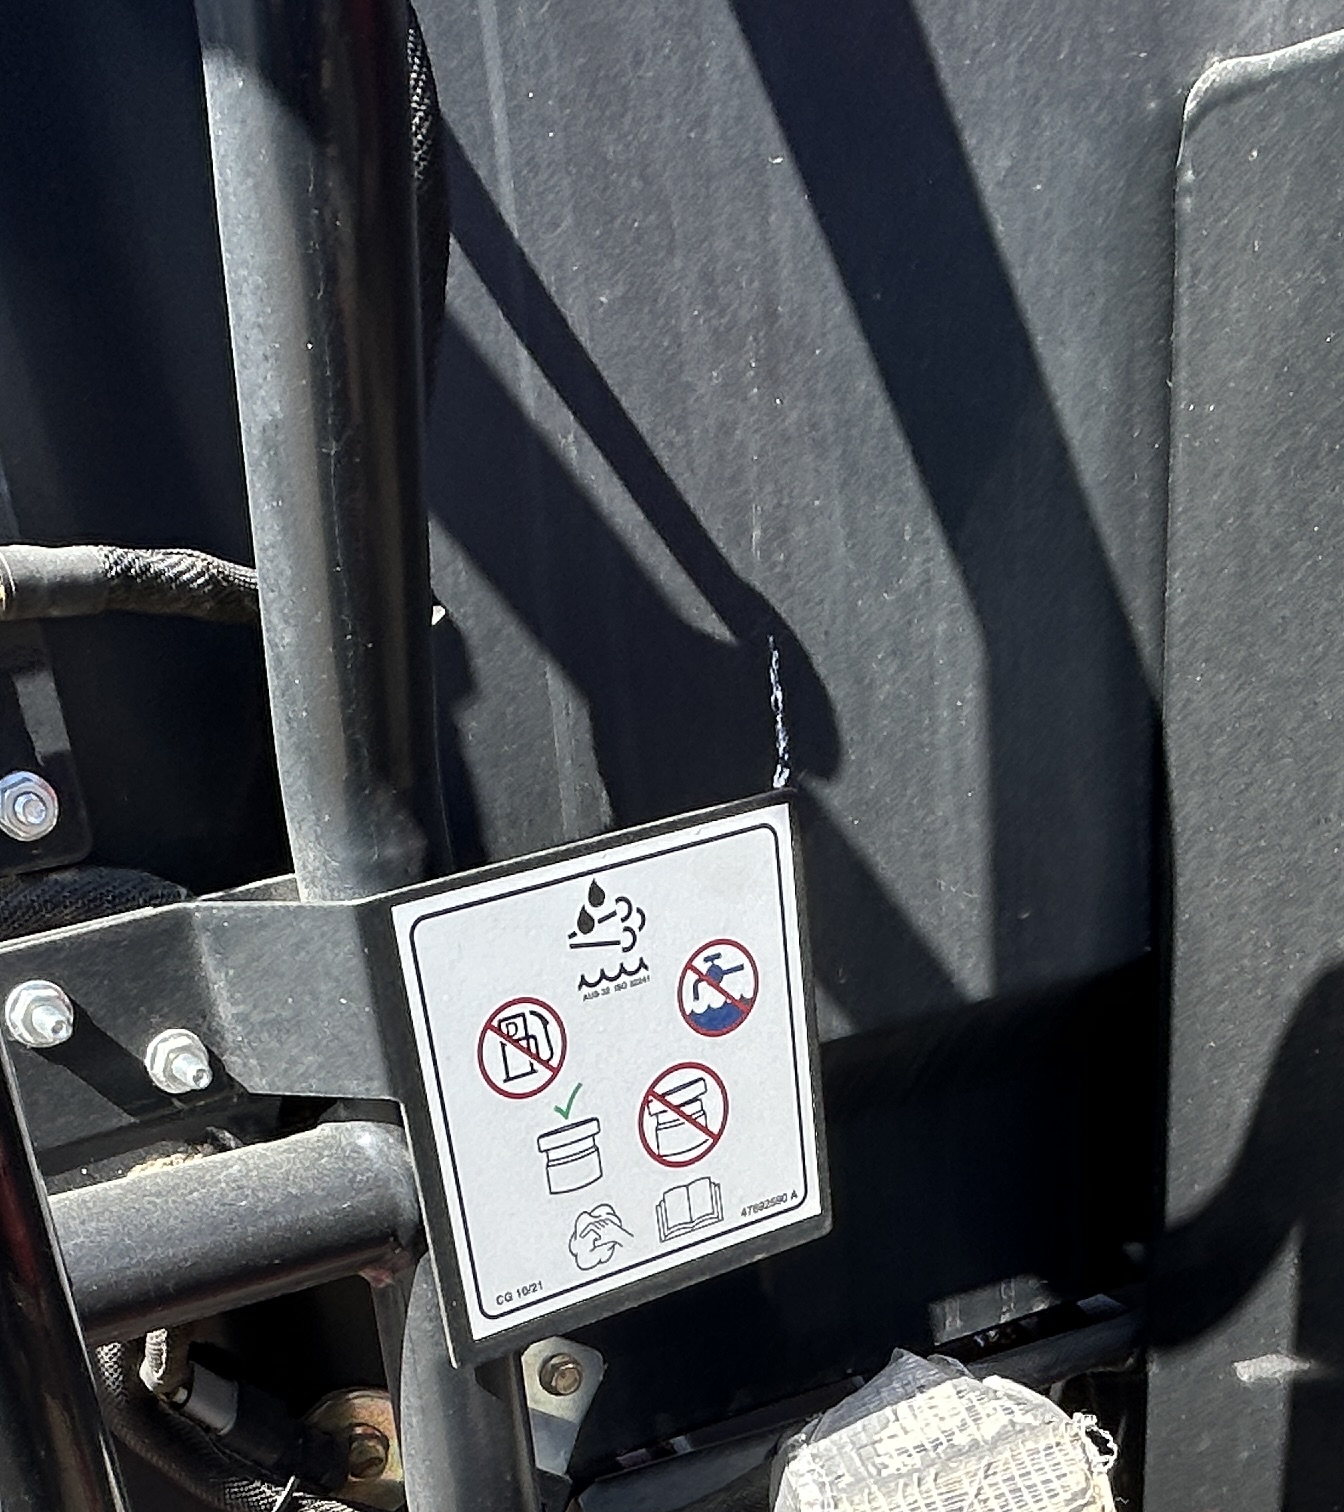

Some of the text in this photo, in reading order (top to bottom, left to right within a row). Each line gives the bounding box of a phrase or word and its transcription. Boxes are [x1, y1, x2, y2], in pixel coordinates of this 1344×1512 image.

[790, 1189, 799, 1201] A
[496, 1280, 544, 1306] CG 10/21
